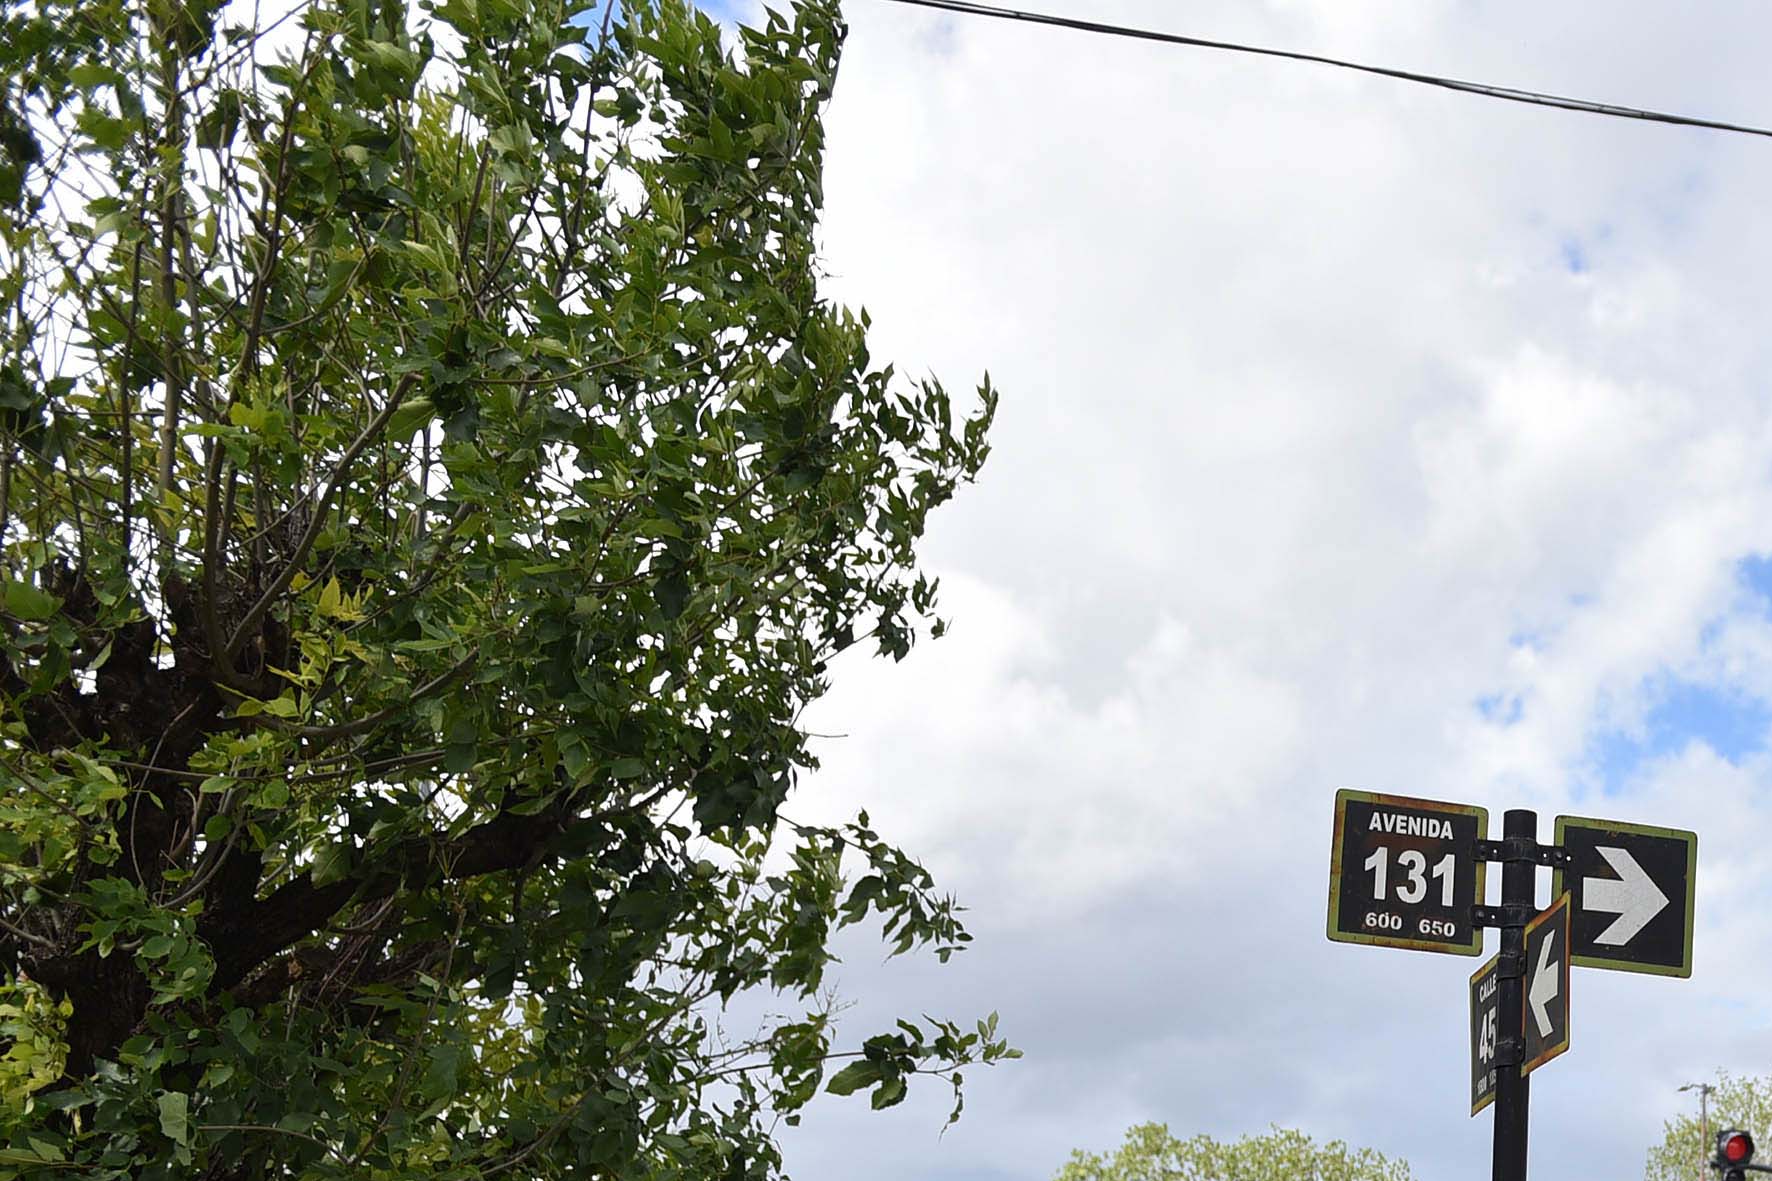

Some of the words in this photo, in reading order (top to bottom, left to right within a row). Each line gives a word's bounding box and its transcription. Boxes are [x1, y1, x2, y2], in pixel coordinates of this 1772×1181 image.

[1369, 811, 1454, 840] AVENIDA
[1364, 846, 1455, 907] 131
[1365, 912, 1402, 930] 600
[1418, 918, 1456, 937] 650
[1479, 973, 1497, 1003] CALLE
[1479, 1006, 1497, 1065] 45
